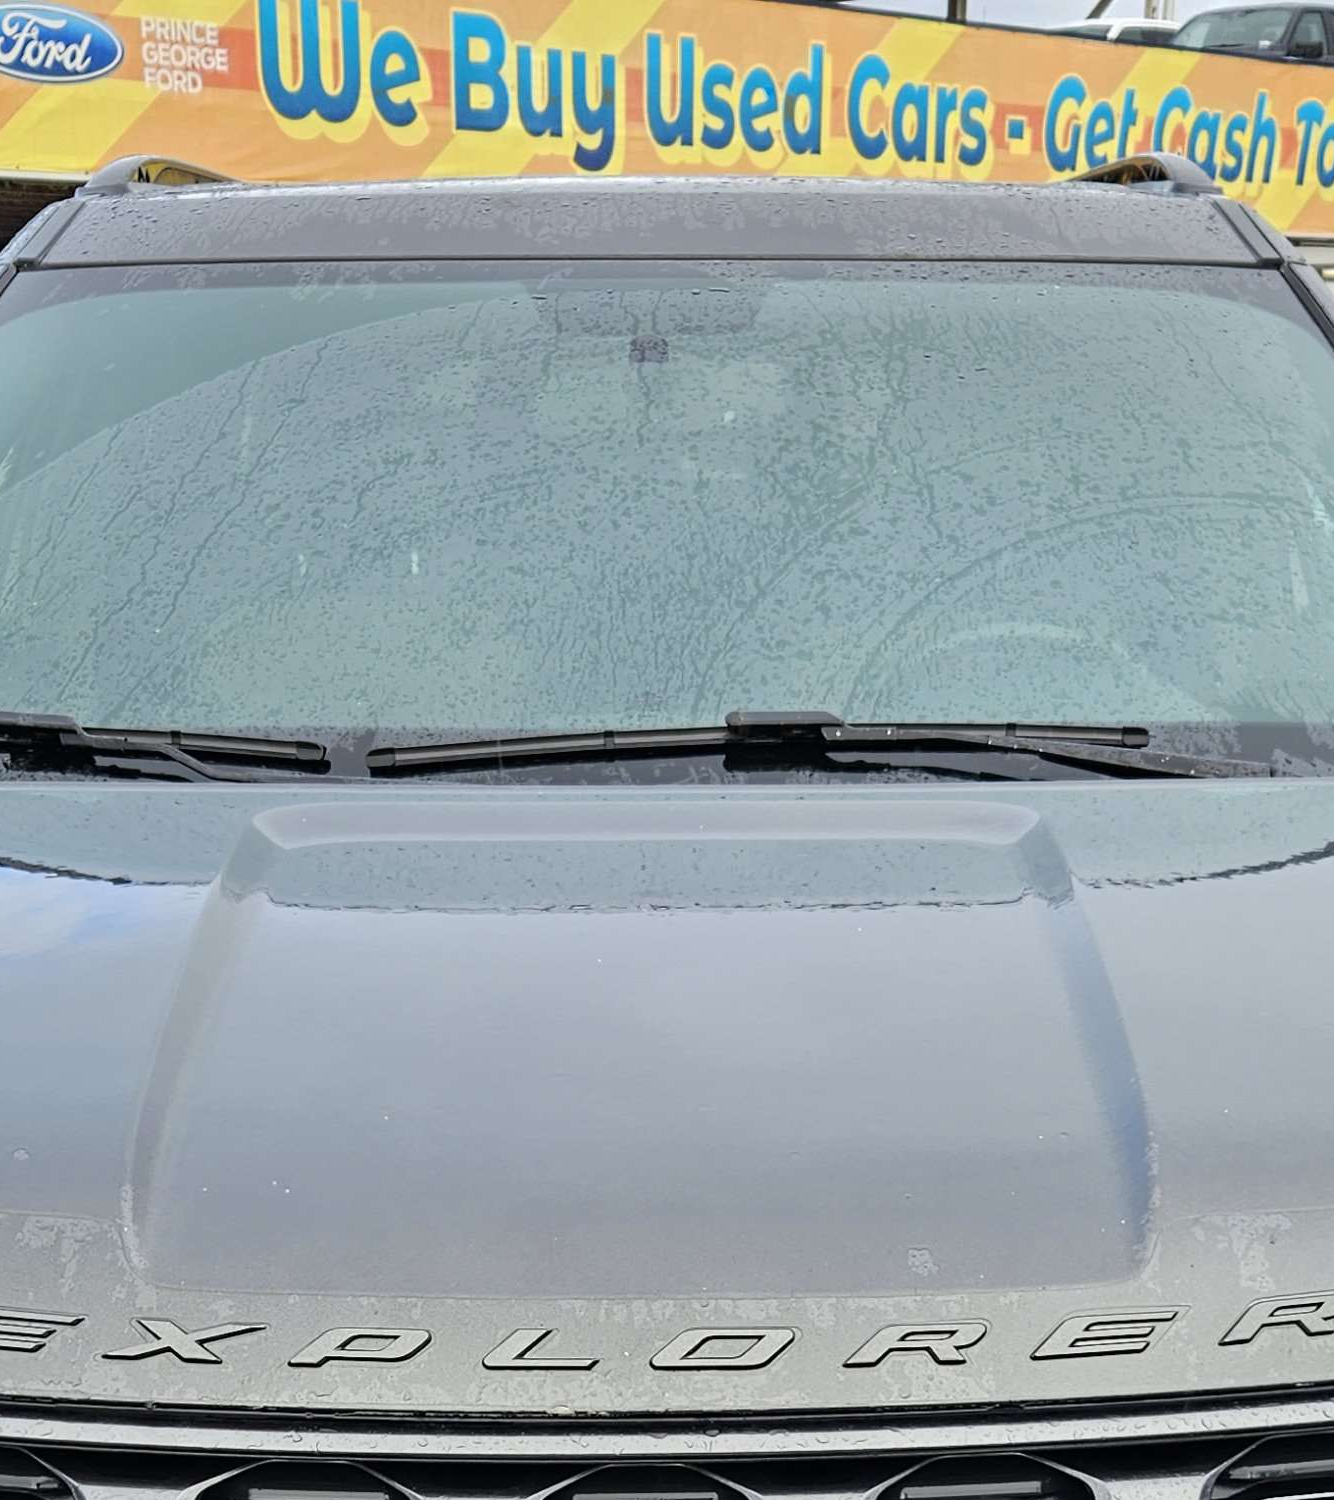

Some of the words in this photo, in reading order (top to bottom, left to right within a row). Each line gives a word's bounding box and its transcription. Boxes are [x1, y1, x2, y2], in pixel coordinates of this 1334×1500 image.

[140, 16, 219, 46] PRINCE
[141, 42, 229, 73] GEORGE
[144, 67, 204, 95] FORD
[255, 0, 422, 128] We
[451, 9, 617, 172] Buy
[644, 32, 826, 156] Used
[846, 52, 990, 167] Cars
[1043, 74, 1138, 173] Get
[1152, 86, 1277, 184] Cash
